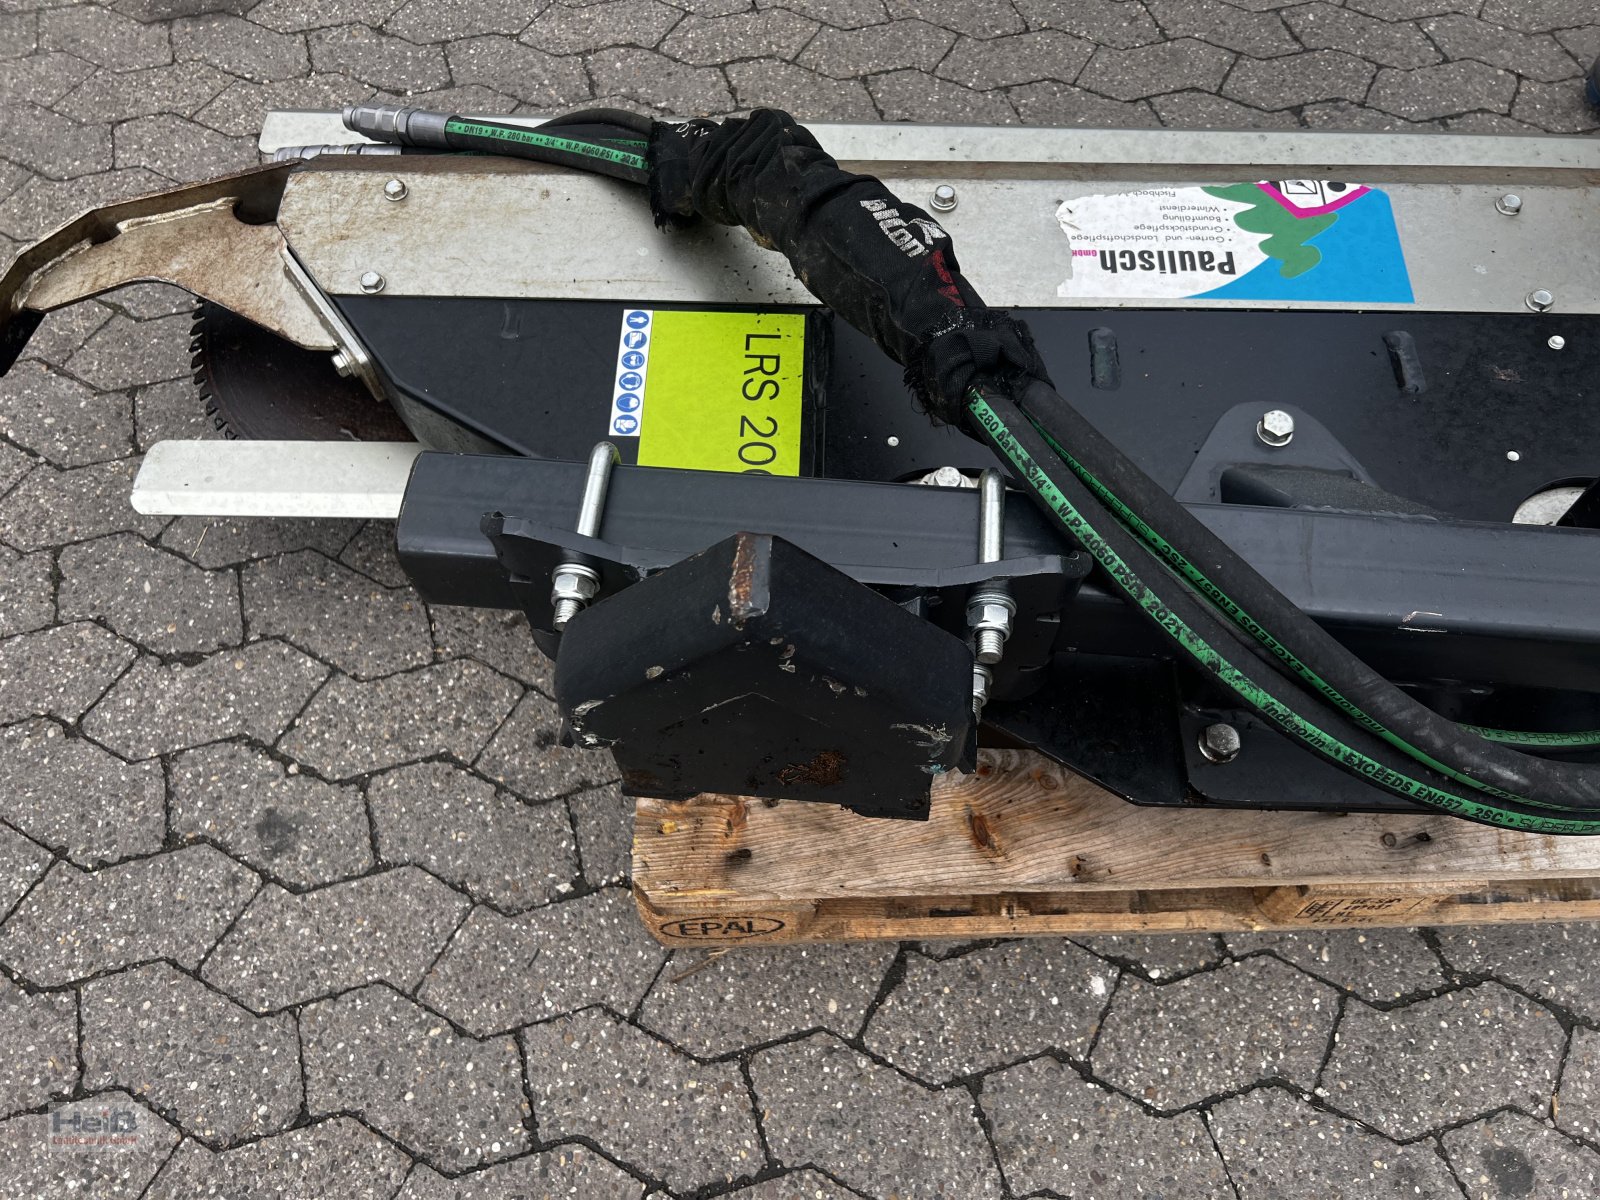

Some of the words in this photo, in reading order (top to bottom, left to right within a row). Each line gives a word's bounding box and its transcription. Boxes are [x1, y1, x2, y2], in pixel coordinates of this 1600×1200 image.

[464, 126, 483, 134] DN19
[521, 134, 533, 142] bar
[1159, 204, 1220, 213] Winterdienst
[1162, 214, 1221, 223] Baumfällung
[1071, 234, 1158, 242] Landschaftspflege
[1134, 224, 1223, 232] Grundstückspflege
[1186, 234, 1225, 243] Garten-
[1100, 250, 1236, 275] Paulisch
[742, 334, 781, 401] LRS
[738, 415, 778, 475] 20
[1161, 544, 1186, 568] 2SC
[1197, 577, 1239, 616] EN857
[977, 408, 999, 432] 280
[995, 430, 1016, 453] bar
[1057, 502, 1083, 534] W.P.
[1082, 530, 1114, 567] 4060
[1343, 753, 1413, 792] EXCEEDS
[1472, 807, 1503, 822] 2SC
[1239, 615, 1303, 673] EXCEEDS
[679, 921, 767, 935] EPAL
